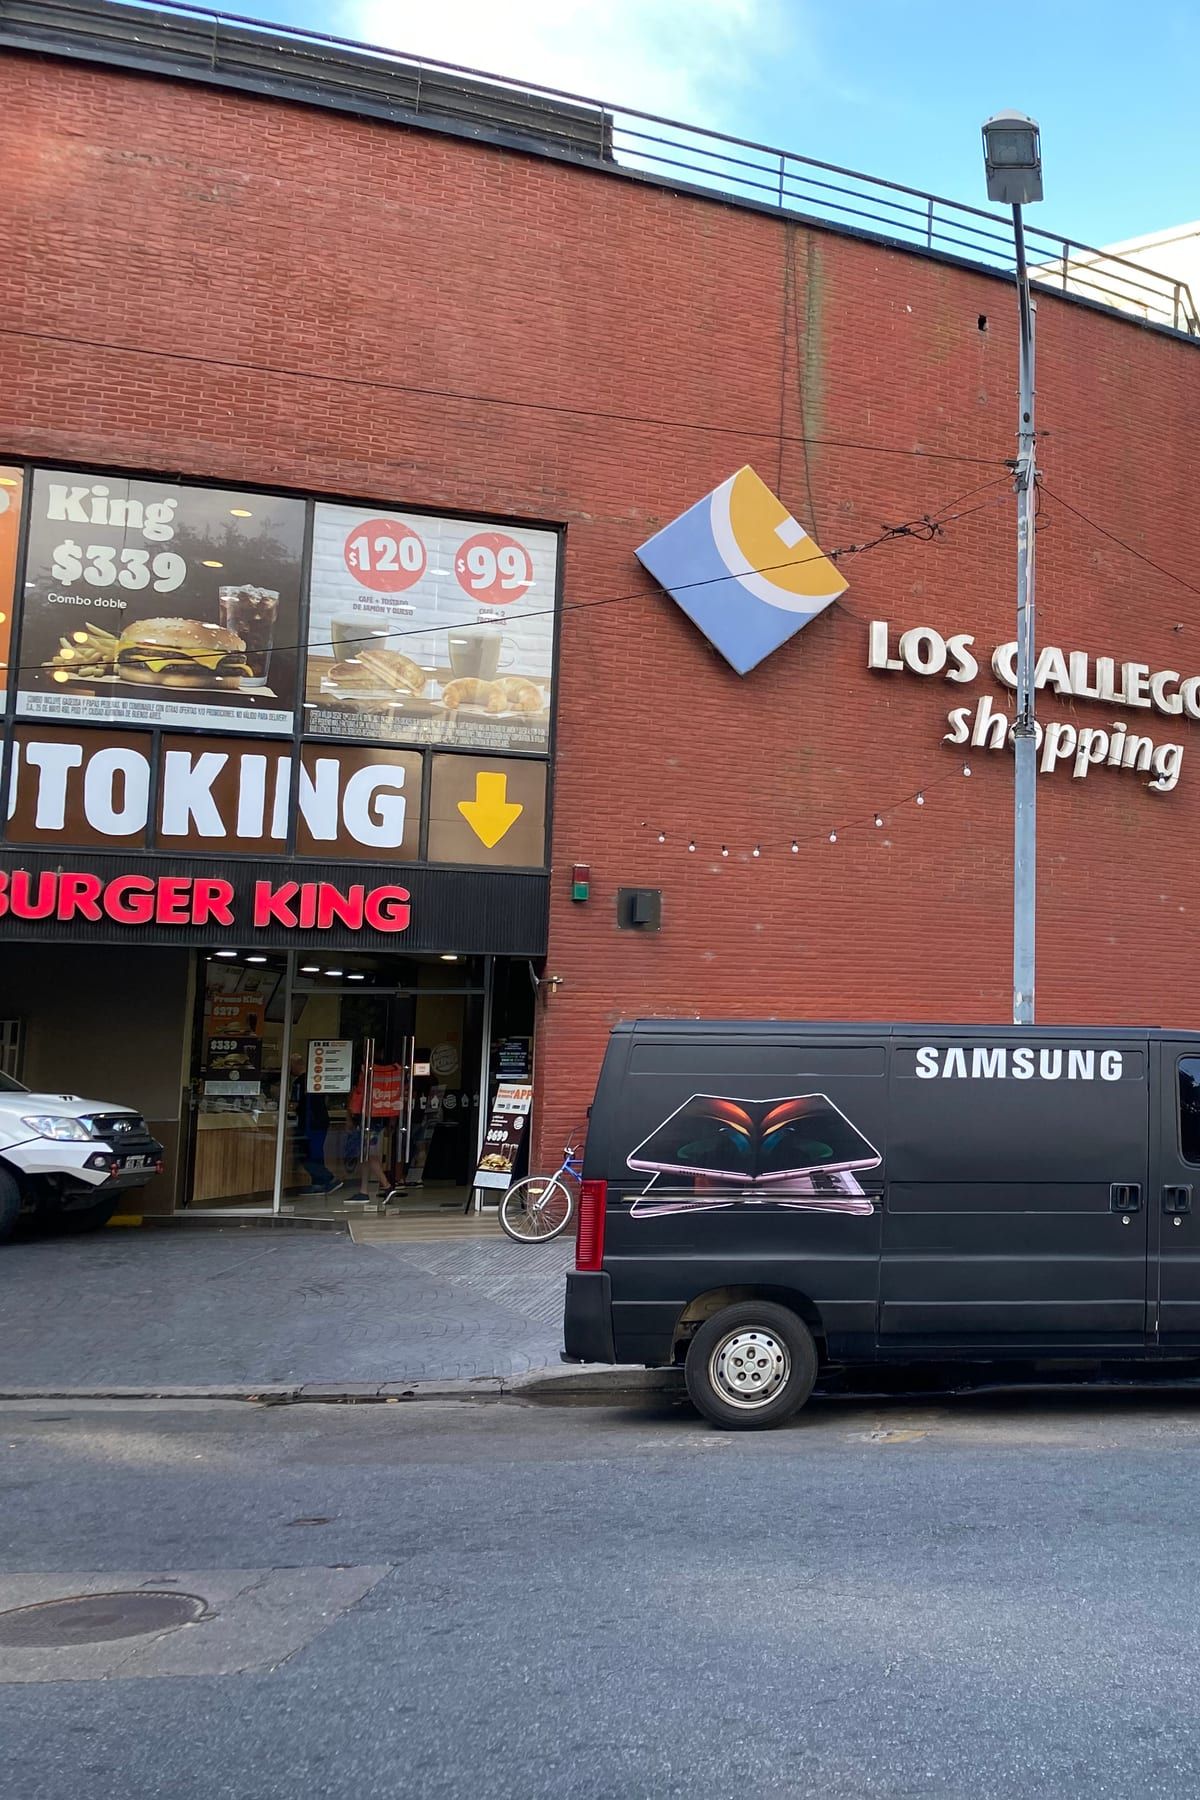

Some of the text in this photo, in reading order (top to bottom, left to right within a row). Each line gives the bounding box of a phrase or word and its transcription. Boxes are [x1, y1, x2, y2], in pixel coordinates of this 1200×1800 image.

[47, 484, 178, 542] King
[51, 540, 187, 593] $339
[349, 536, 424, 572] $120
[457, 546, 528, 590] $99
[47, 592, 128, 610] Combo doble
[866, 620, 979, 683] LOS
[253, 880, 411, 933] KING
[210, 1040, 238, 1050] $339
[915, 1046, 1123, 1081] SAMSUNG
[486, 1129, 508, 1142] $699
